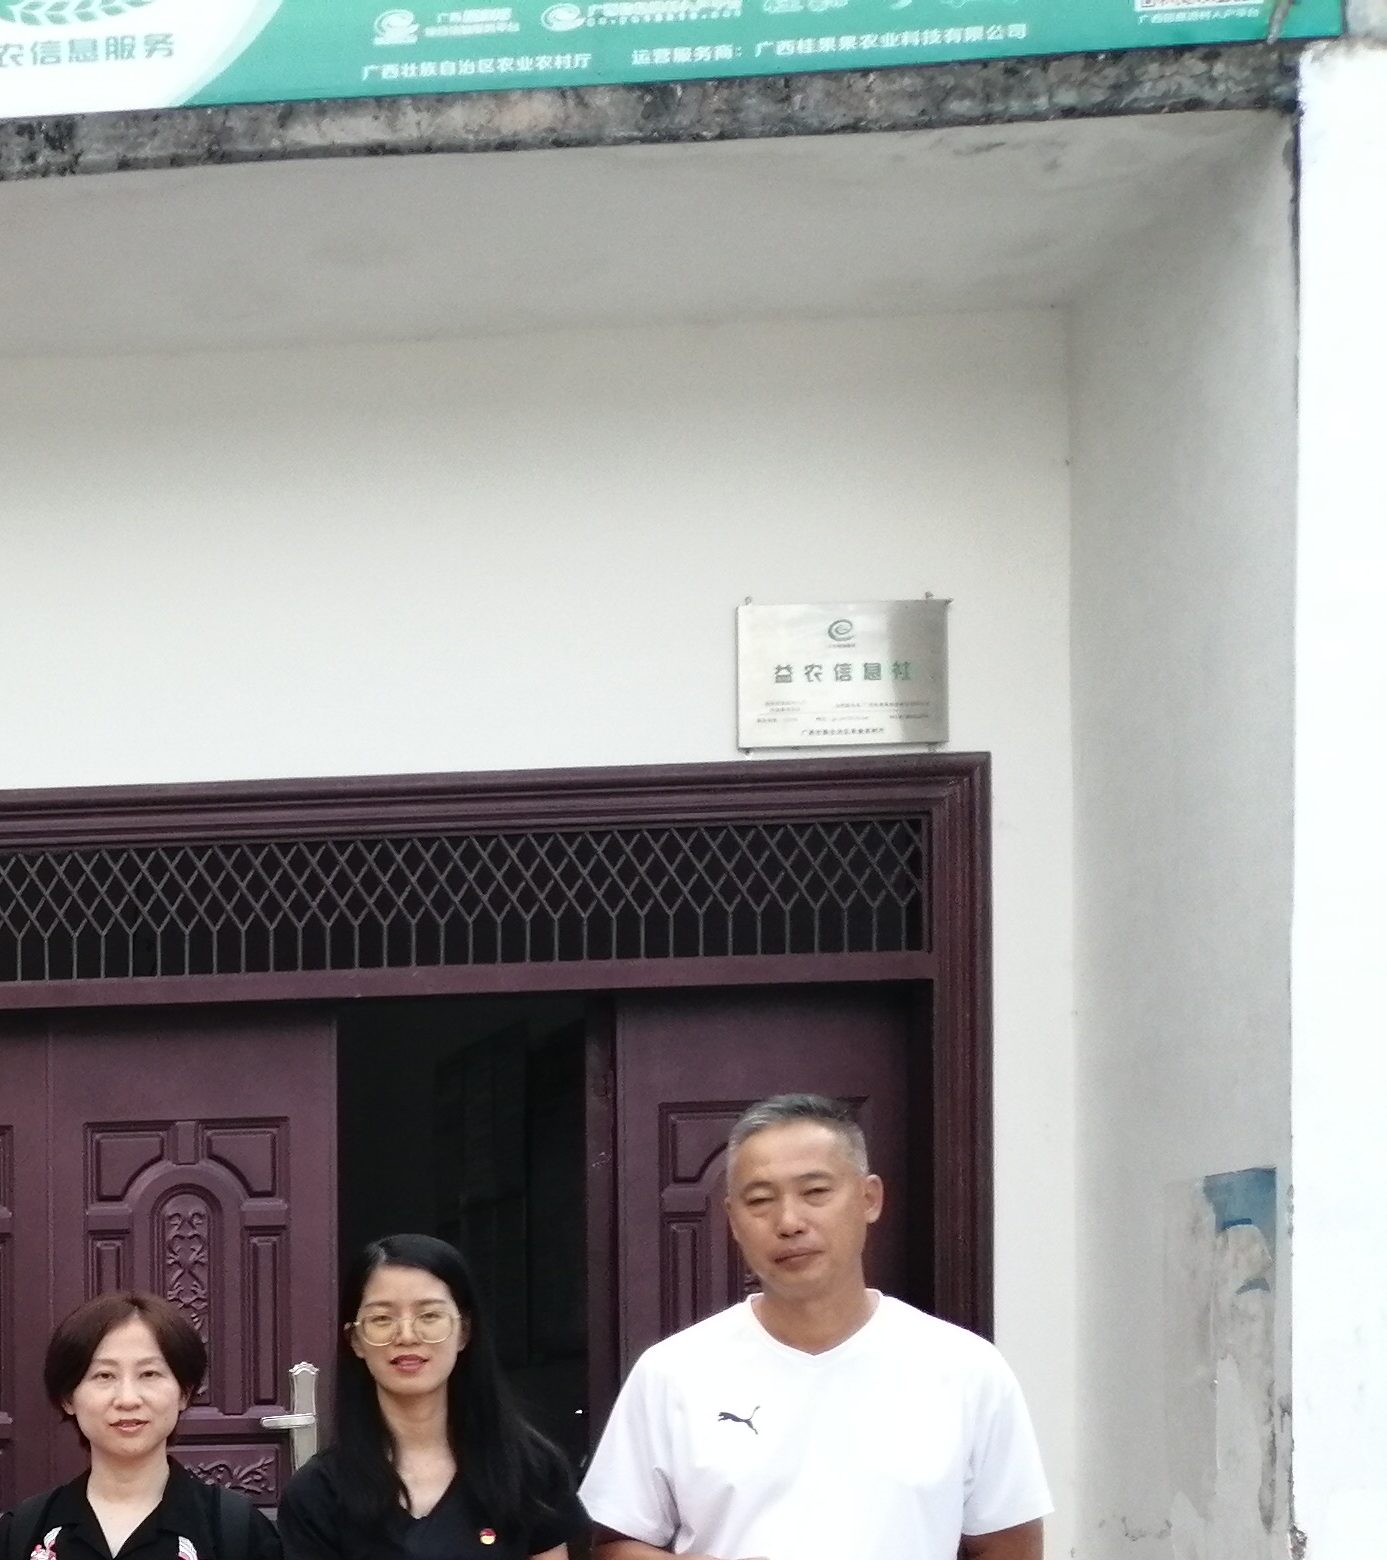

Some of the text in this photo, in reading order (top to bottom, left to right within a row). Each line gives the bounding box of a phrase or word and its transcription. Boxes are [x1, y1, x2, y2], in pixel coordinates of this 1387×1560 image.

[362, 53, 593, 81] 广西壮族自治区农业农村厅
[774, 660, 912, 684] 益农信息社
